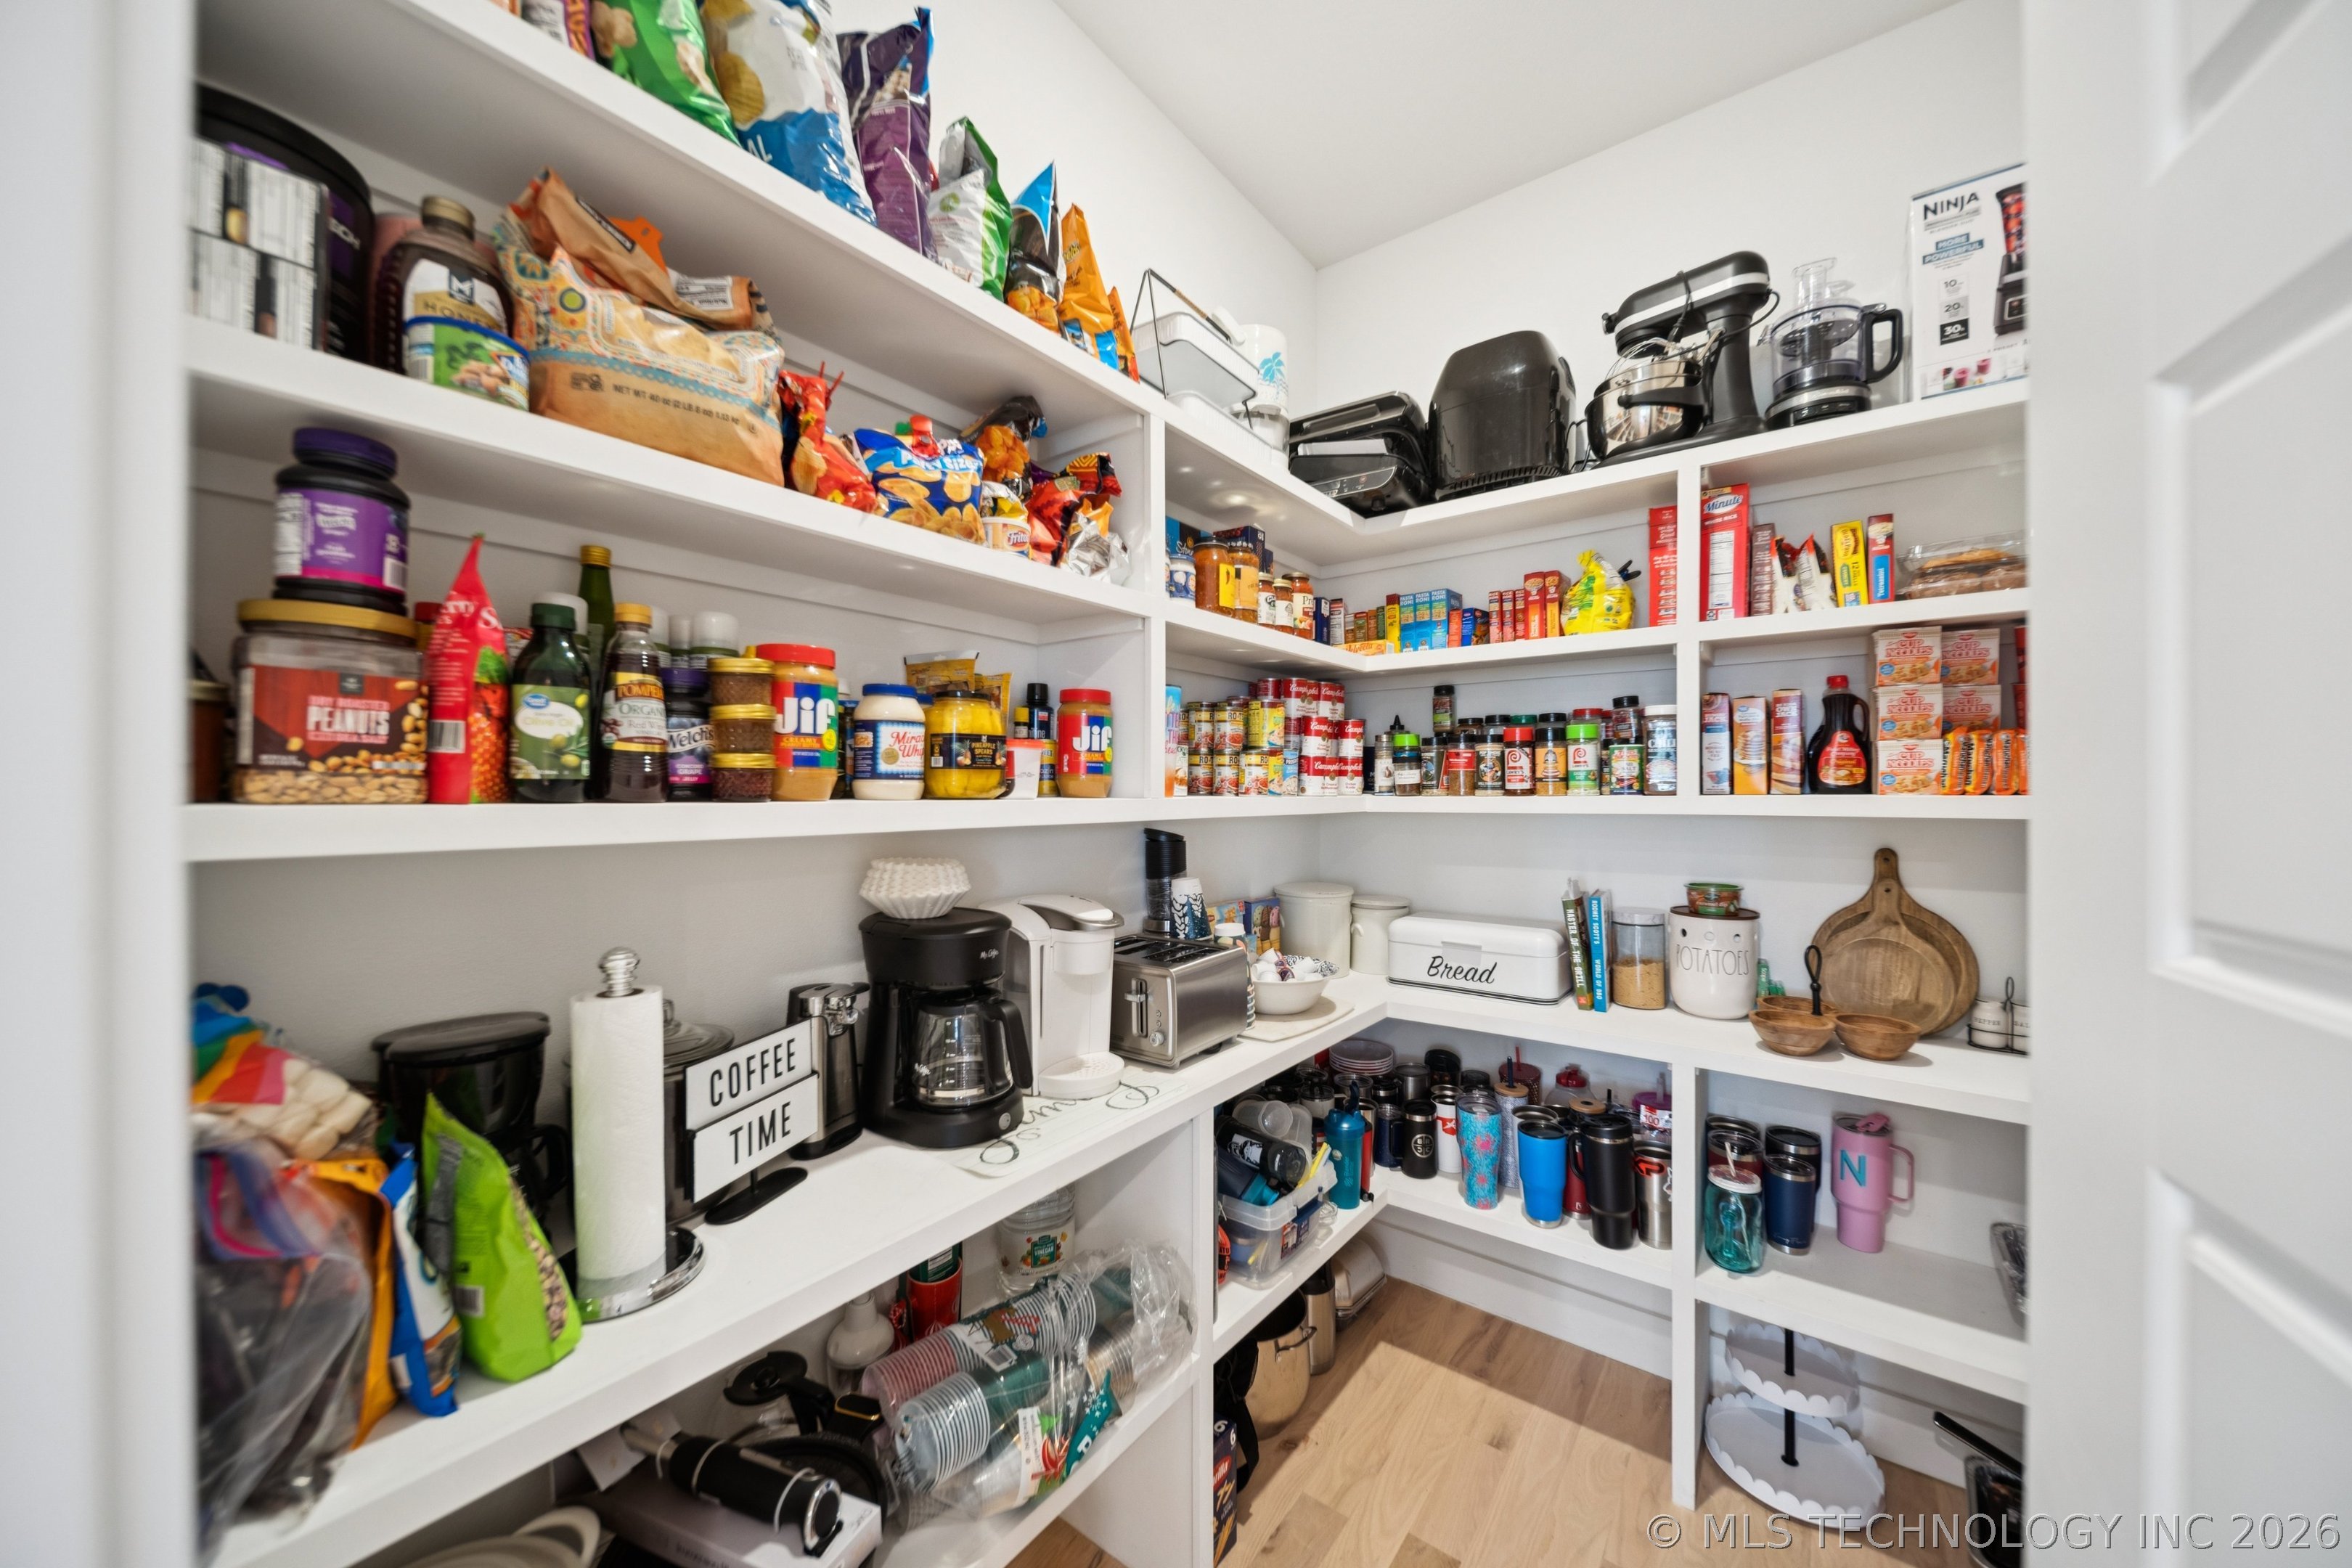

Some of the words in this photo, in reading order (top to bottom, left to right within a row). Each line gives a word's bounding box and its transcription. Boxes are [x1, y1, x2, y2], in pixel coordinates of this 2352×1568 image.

[1923, 192, 1980, 221] NINJA
[1937, 234, 1968, 247] MORE
[1924, 241, 1983, 262] POWERFUL
[1944, 279, 1957, 288] 10
[1945, 302, 1961, 313] 20
[1943, 324, 1961, 335] 30
[1704, 495, 1744, 512] Minute
[1897, 639, 1924, 648] CUP
[1953, 641, 1981, 650] CUP
[1885, 646, 1934, 658] NOODLES
[1942, 648, 1990, 659] NOODLES
[1898, 696, 1925, 705] CUP
[1956, 697, 1983, 706] CUP
[774, 696, 836, 735] Jif
[1887, 703, 1935, 714] NOODLES
[1943, 704, 1992, 714] NOODLES
[306, 706, 390, 735] PEANUTS
[668, 727, 714, 749] Welch's
[1072, 725, 1112, 751] Jif
[1898, 751, 1925, 759] CUP
[1886, 759, 1935, 769] NOODLES
[1567, 909, 1577, 935] MASTER
[1570, 937, 1580, 947] OF
[1572, 950, 1582, 964] THE
[1675, 944, 1750, 976] POTATOES
[1426, 955, 1498, 984] Bread
[1594, 959, 1603, 979] WORLD
[1574, 966, 1586, 988] GRILL
[709, 1037, 797, 1108] COFFEE
[729, 1101, 792, 1165] TIME
[1839, 1149, 1867, 1187] N
[1034, 1245, 1055, 1257] VINEGAR
[1214, 1419, 1228, 1433] 6
[1230, 1427, 1236, 1446] 6
[1213, 1460, 1230, 1484] rilla
